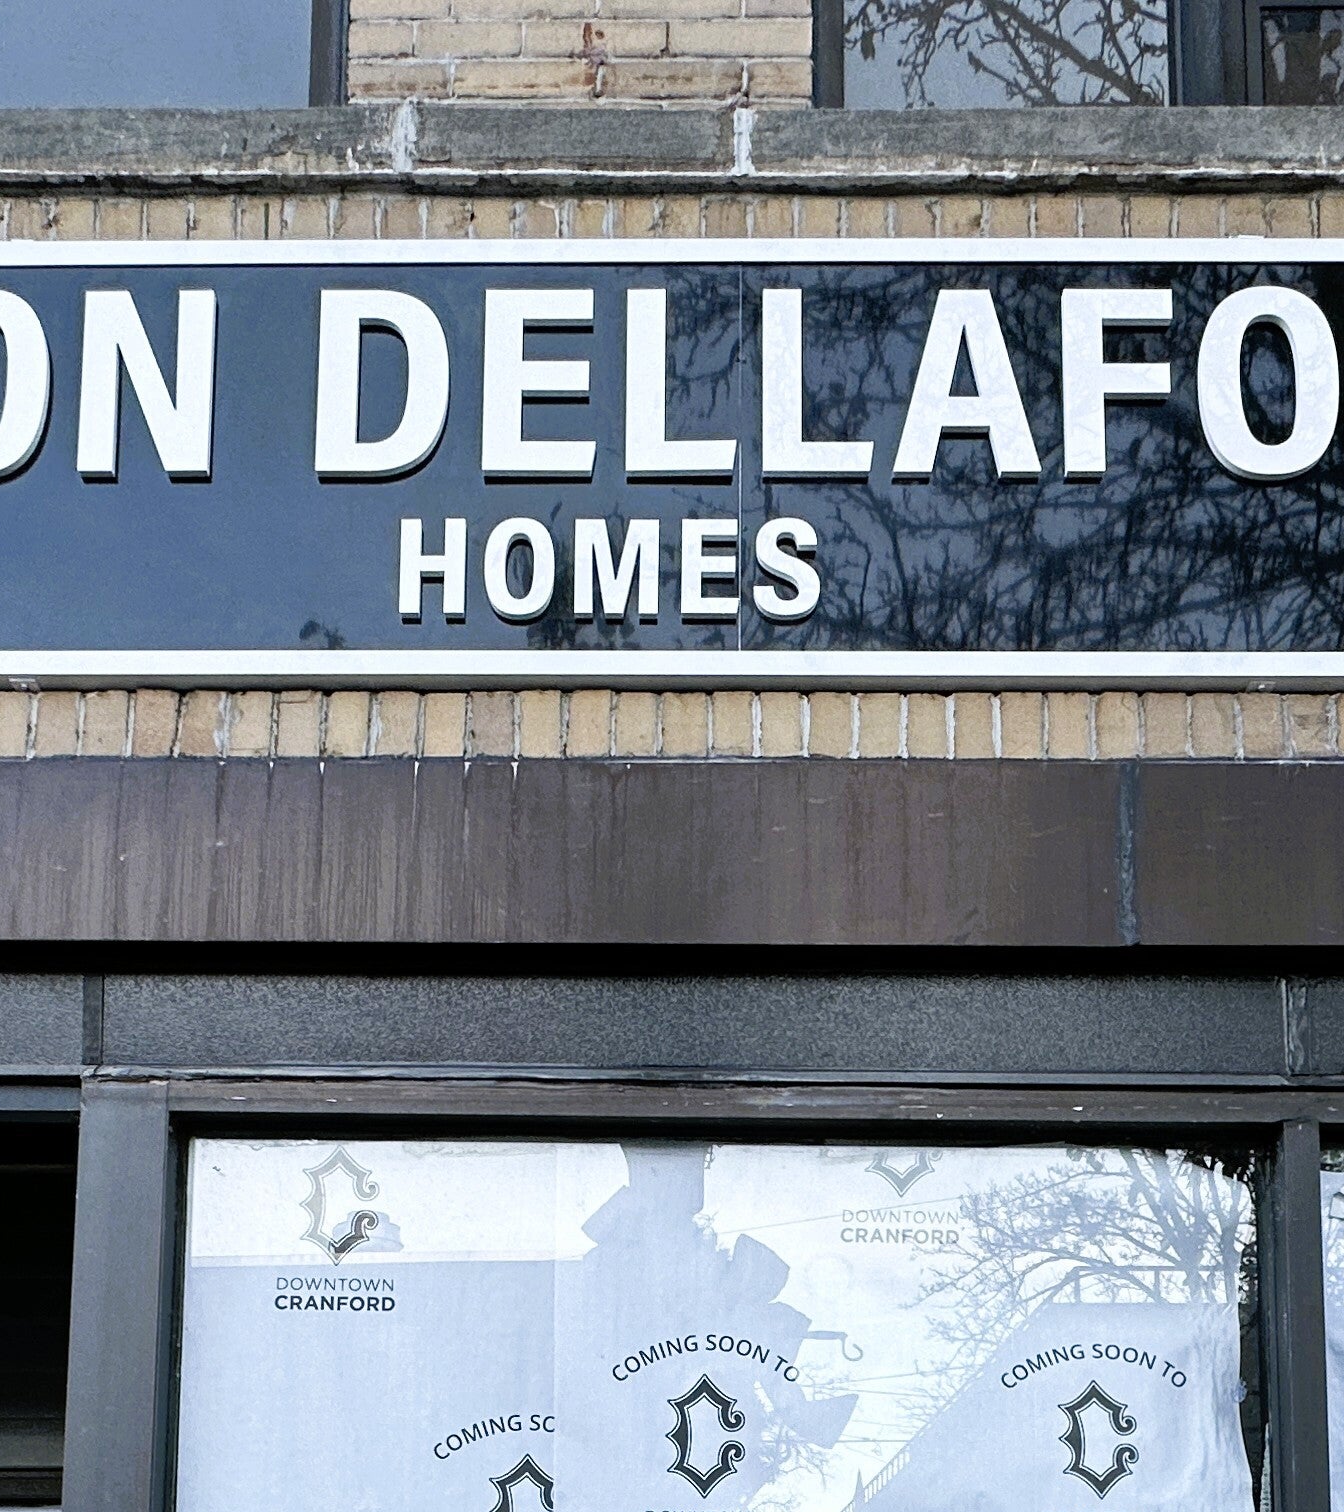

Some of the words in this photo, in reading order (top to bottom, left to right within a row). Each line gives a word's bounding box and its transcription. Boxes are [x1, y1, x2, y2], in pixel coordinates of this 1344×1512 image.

[399, 516, 824, 624] HOMES
[841, 1209, 959, 1225] DOWNTOWN
[840, 1228, 960, 1245] CRANFORD
[276, 1277, 395, 1292] DOWNTOWN
[274, 1295, 396, 1312] CRANFORD
[612, 1334, 699, 1383] COMING
[705, 1334, 770, 1365] SOON
[772, 1353, 800, 1383] TO
[1000, 1344, 1085, 1390] COMING
[1092, 1344, 1156, 1368] SOON
[1161, 1361, 1188, 1388] TO
[434, 1415, 522, 1460] COMING
